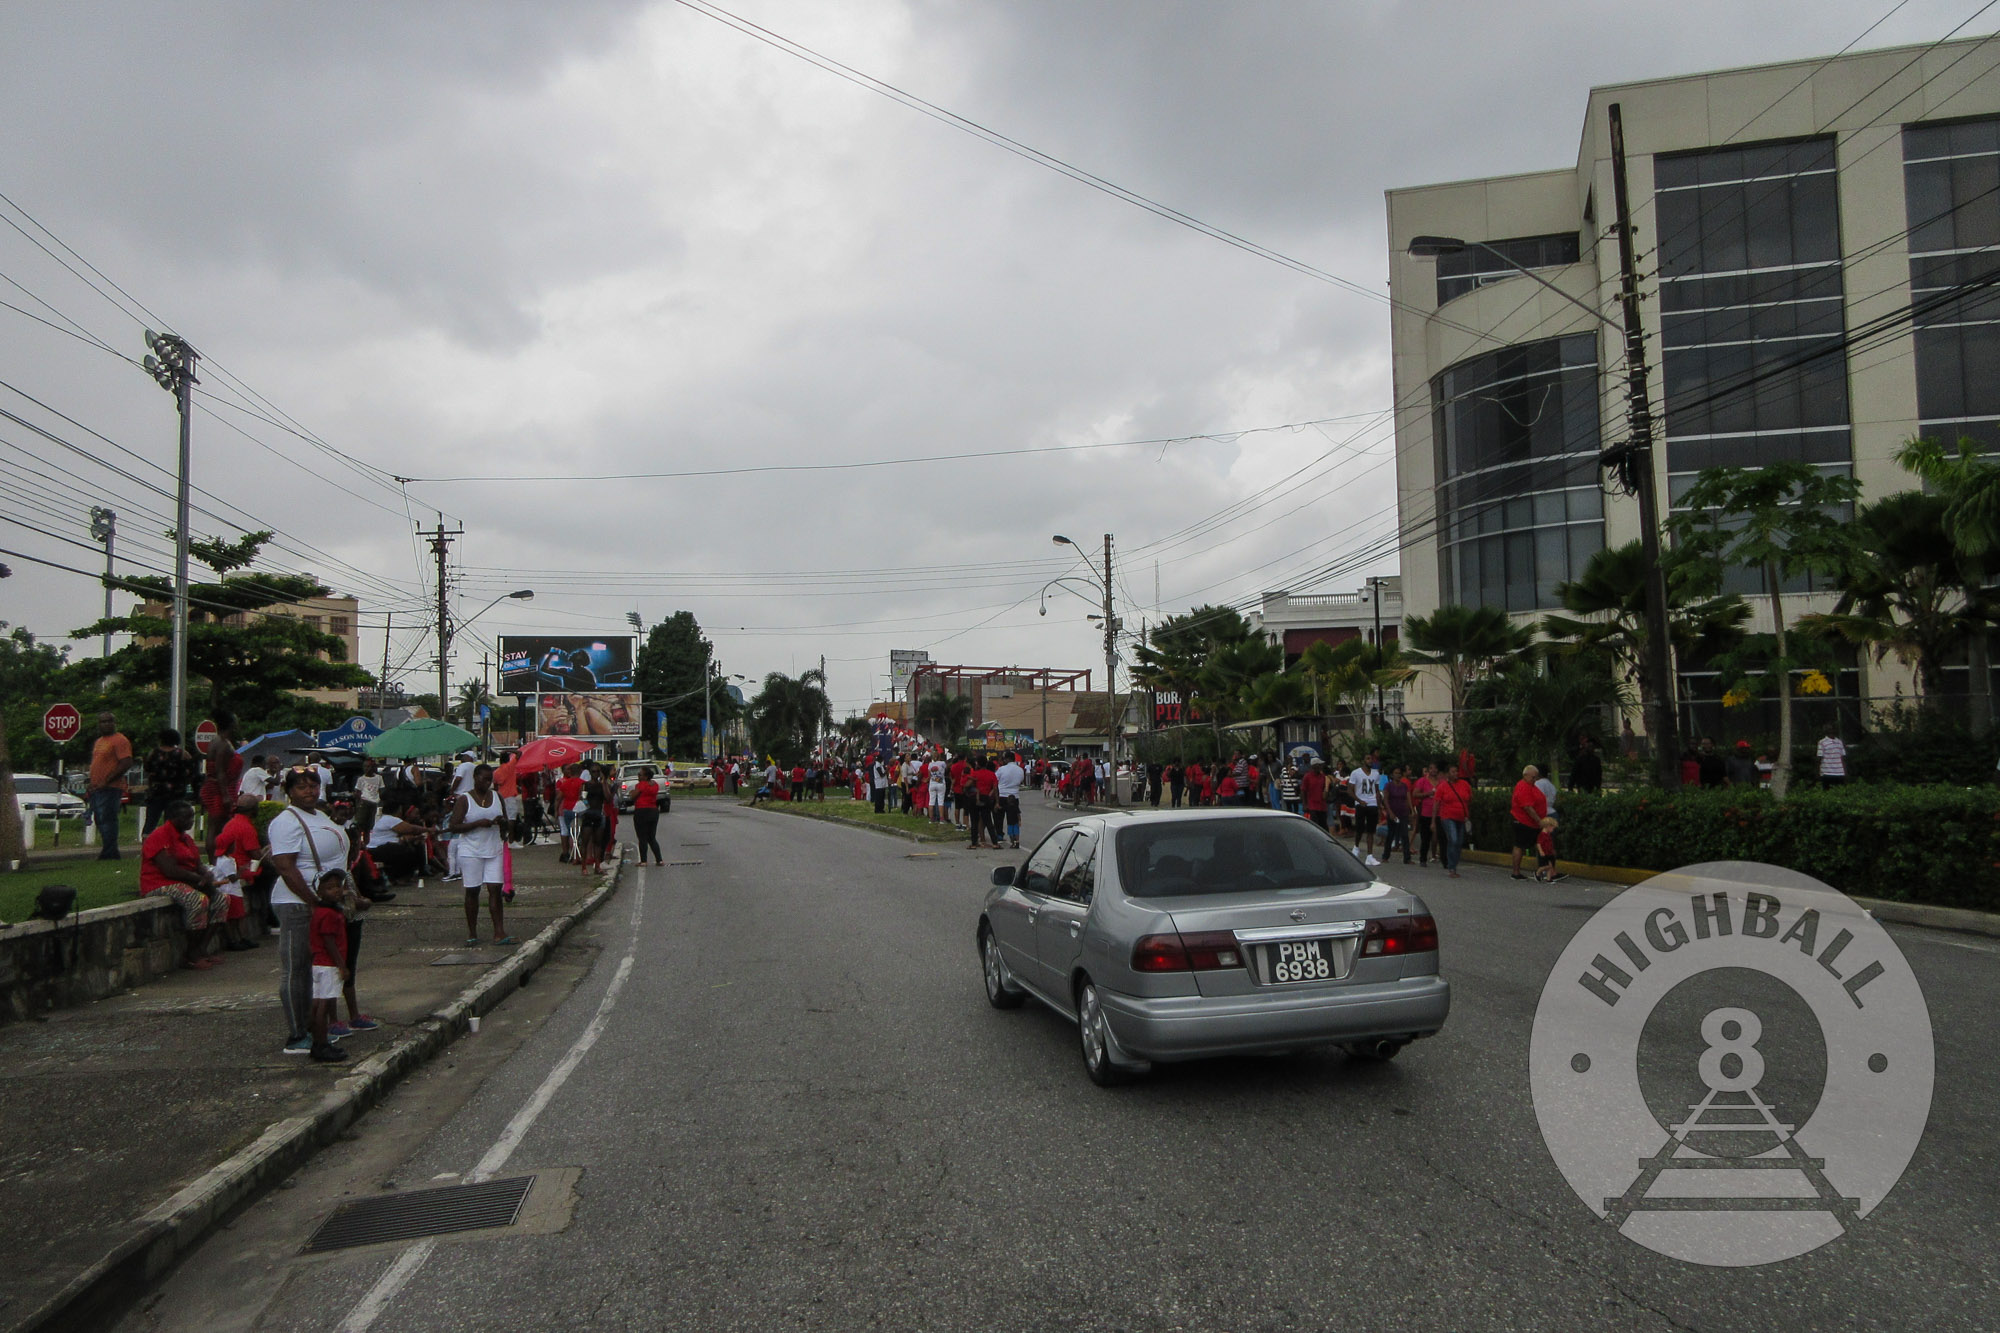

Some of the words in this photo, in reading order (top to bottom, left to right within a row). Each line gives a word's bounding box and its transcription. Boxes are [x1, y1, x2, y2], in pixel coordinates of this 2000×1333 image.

[504, 650, 528, 661] STAY
[1156, 703, 1201, 721] PIZA
[48, 716, 76, 729] STOP
[325, 733, 355, 747] NELSON
[1279, 941, 1321, 962] PBM
[1275, 958, 1330, 981] 6938
